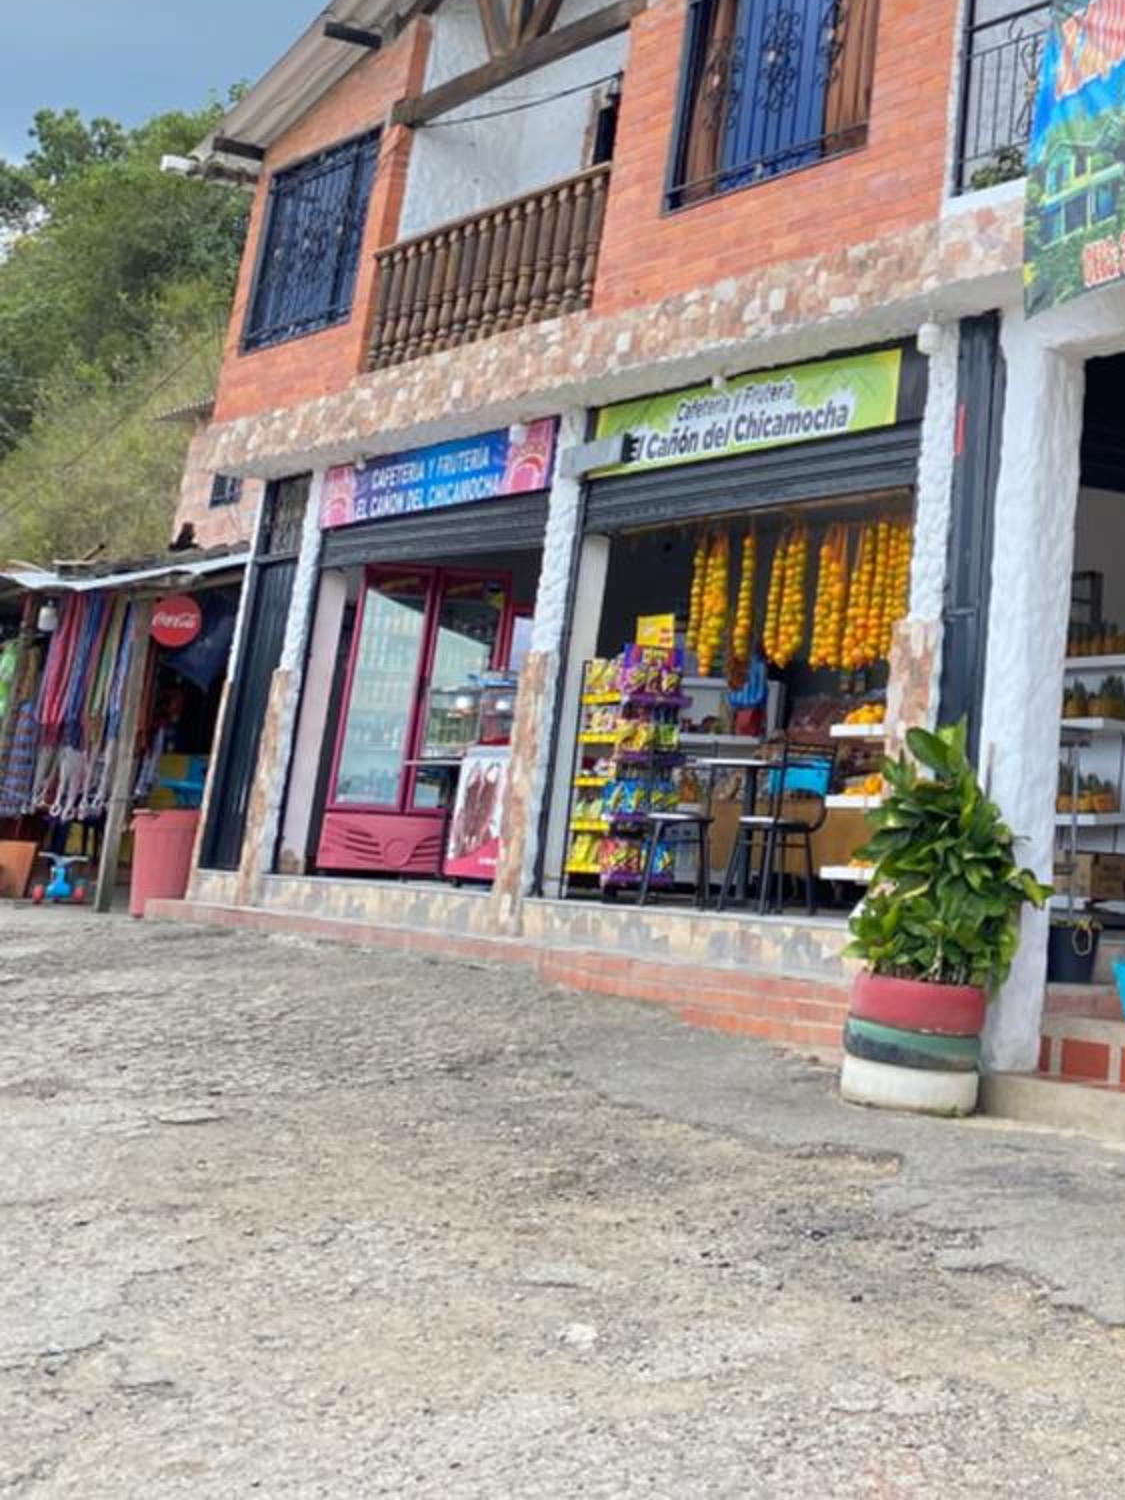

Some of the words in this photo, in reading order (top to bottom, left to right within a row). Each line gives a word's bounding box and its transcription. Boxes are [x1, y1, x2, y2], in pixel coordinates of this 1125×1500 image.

[646, 425, 699, 460] Cañón
[703, 418, 732, 451] del
[734, 399, 850, 442] Chicamocha
